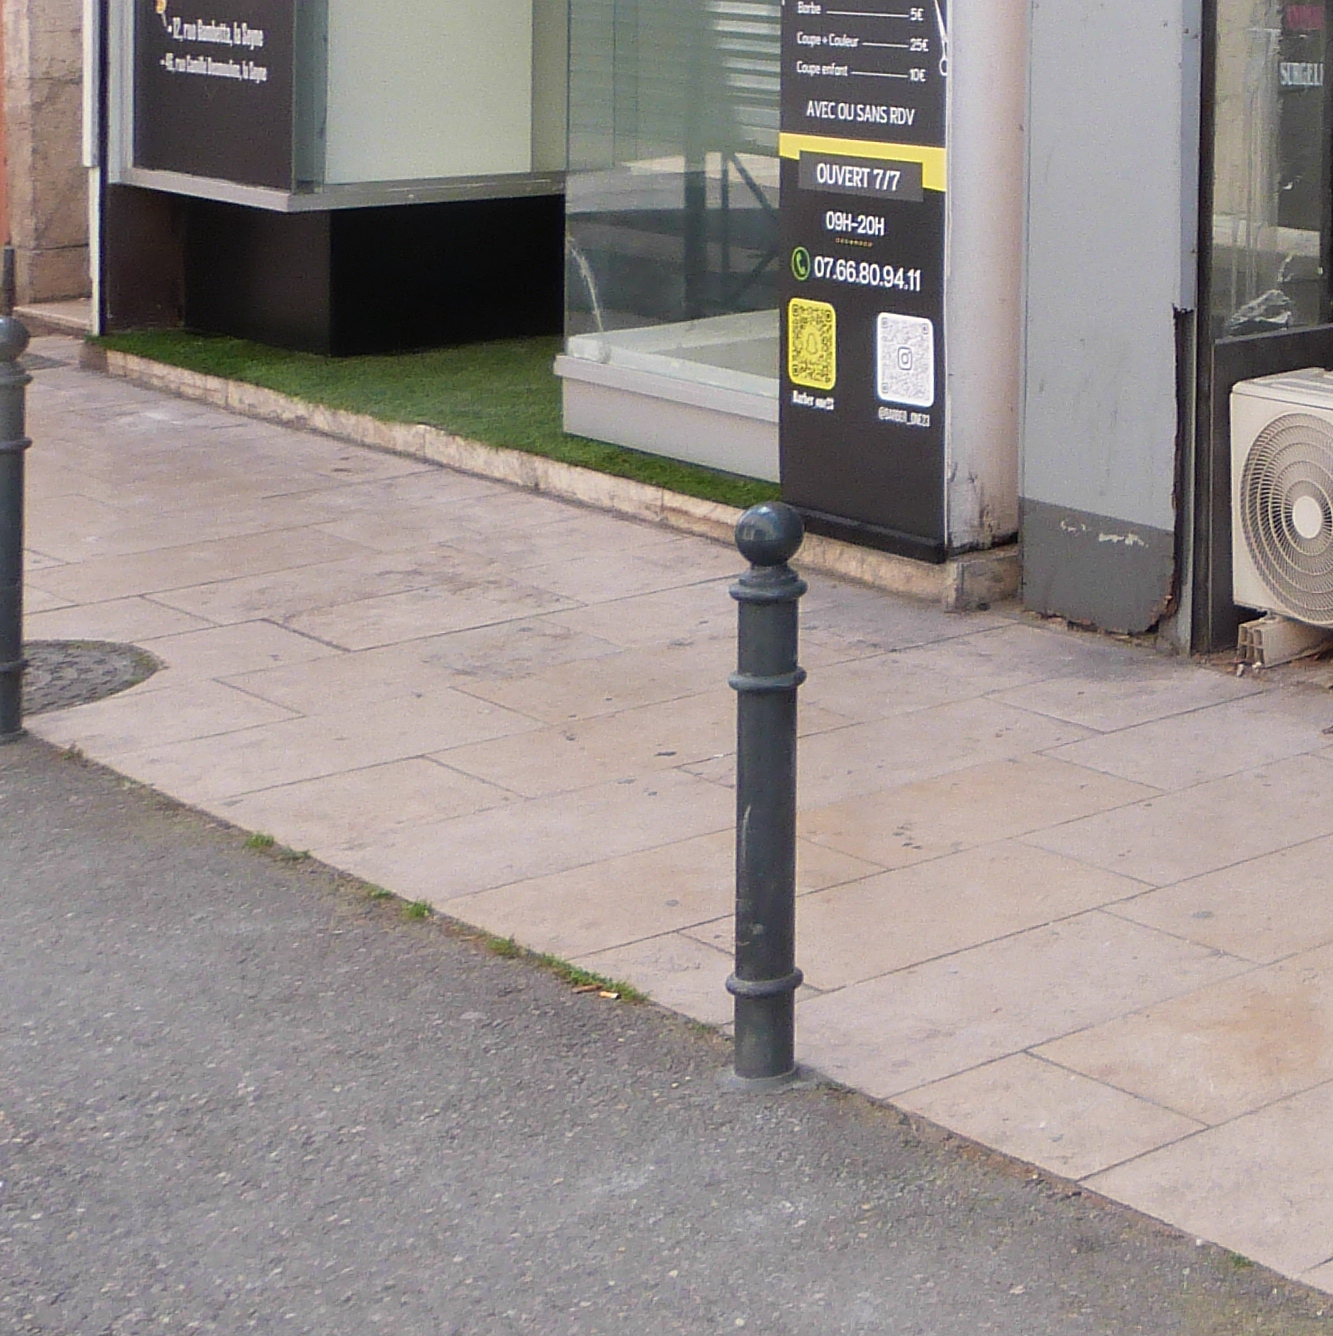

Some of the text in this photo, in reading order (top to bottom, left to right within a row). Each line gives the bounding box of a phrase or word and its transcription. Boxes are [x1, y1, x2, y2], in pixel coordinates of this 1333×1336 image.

[797, 0, 925, 21] Barbe 5€
[796, 31, 821, 48] Coupe
[828, 33, 860, 47] Couleur
[909, 38, 929, 52] 25€
[796, 60, 927, 82] Coupe enfant 10€
[806, 100, 916, 126] AVEC OU SANS RDV
[816, 162, 901, 191] OUVERT 7/7
[825, 211, 885, 236] 09H-20H
[814, 256, 922, 292] 07.66.80.94.11
